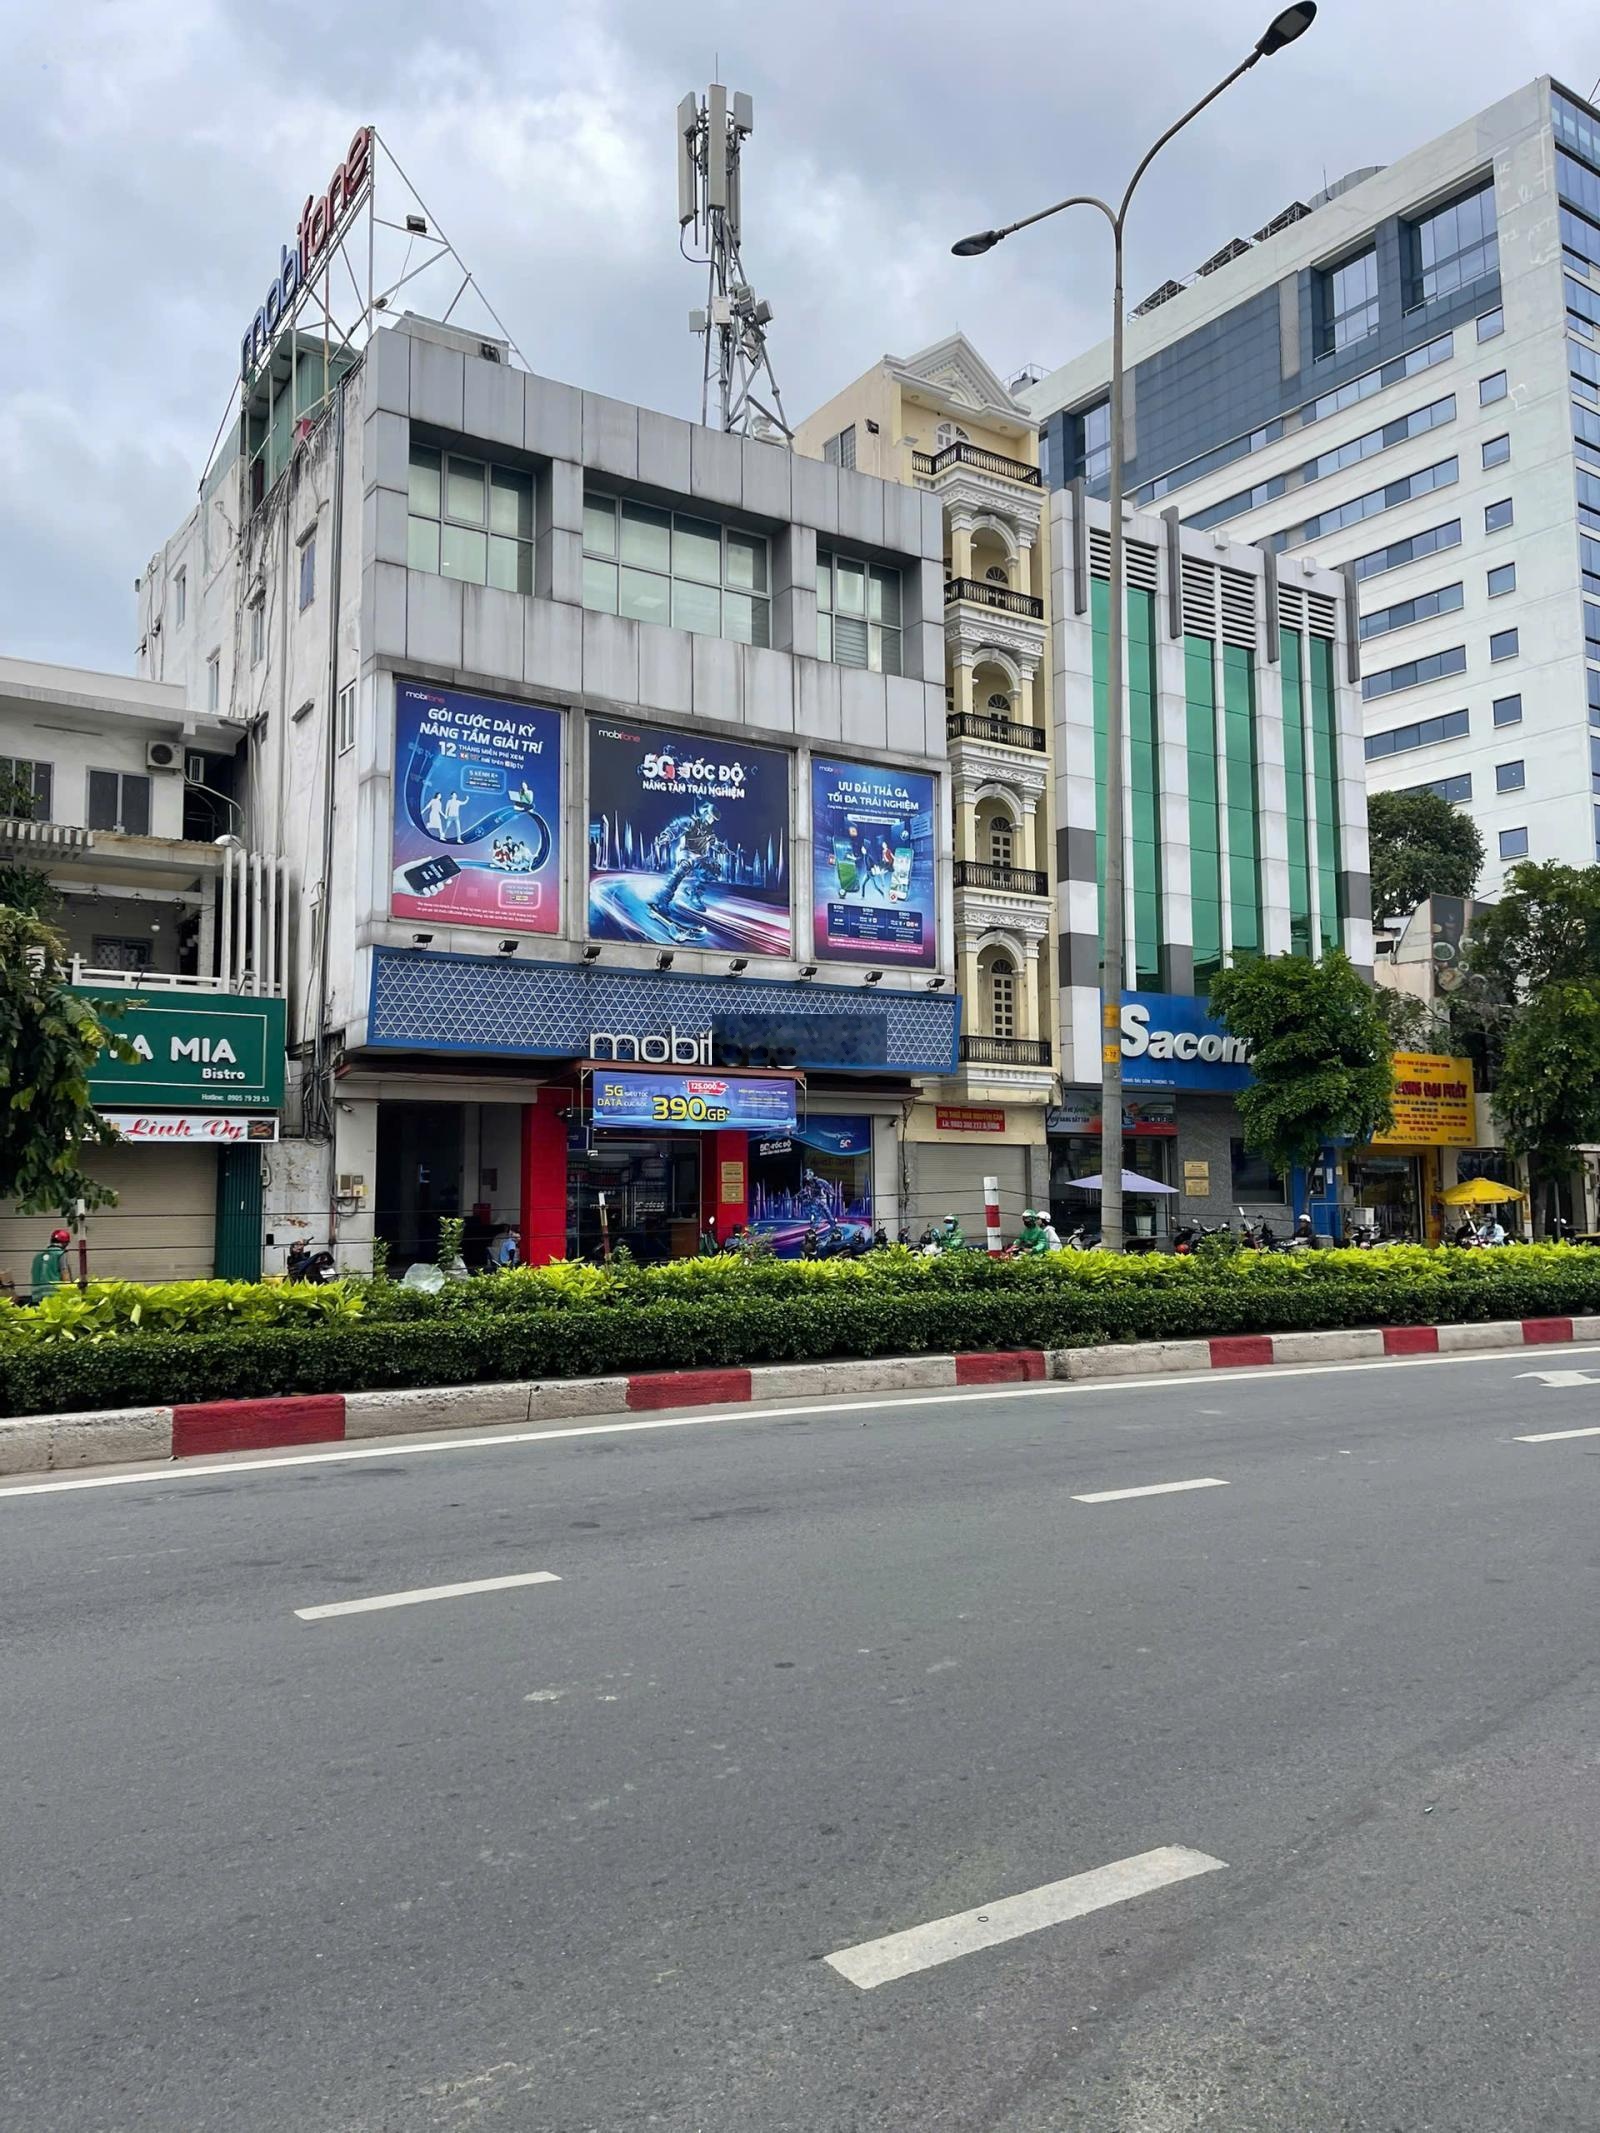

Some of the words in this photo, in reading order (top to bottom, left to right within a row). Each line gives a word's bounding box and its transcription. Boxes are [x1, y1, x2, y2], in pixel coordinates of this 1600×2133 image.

[241, 126, 370, 383] mobifone
[428, 707, 452, 722] GÓI
[455, 713, 491, 729] CƯỚC
[493, 719, 516, 735] DÀI
[518, 723, 536, 737] KỲ
[420, 722, 459, 740] NÂNG
[493, 735, 518, 750] GIẢI
[521, 740, 543, 754] TRÍ
[598, 729, 640, 743] mobifone
[439, 741, 457, 757] 12
[643, 753, 675, 779] 5G
[681, 757, 716, 780] TỐC
[718, 762, 744, 787] ĐỘ
[643, 780, 667, 792] NÂNG
[708, 786, 745, 800] NGHIỆM
[873, 784, 893, 797] THẢ
[894, 788, 909, 798] GA
[828, 791, 843, 802] TỐI
[883, 800, 919, 811] NGHIỆM
[170, 1035, 237, 1064] MIA
[202, 1067, 246, 1080] Bistro
[604, 1084, 624, 1097] 5G
[597, 1098, 623, 1107] DATA
[125, 1118, 194, 1137] Linh
